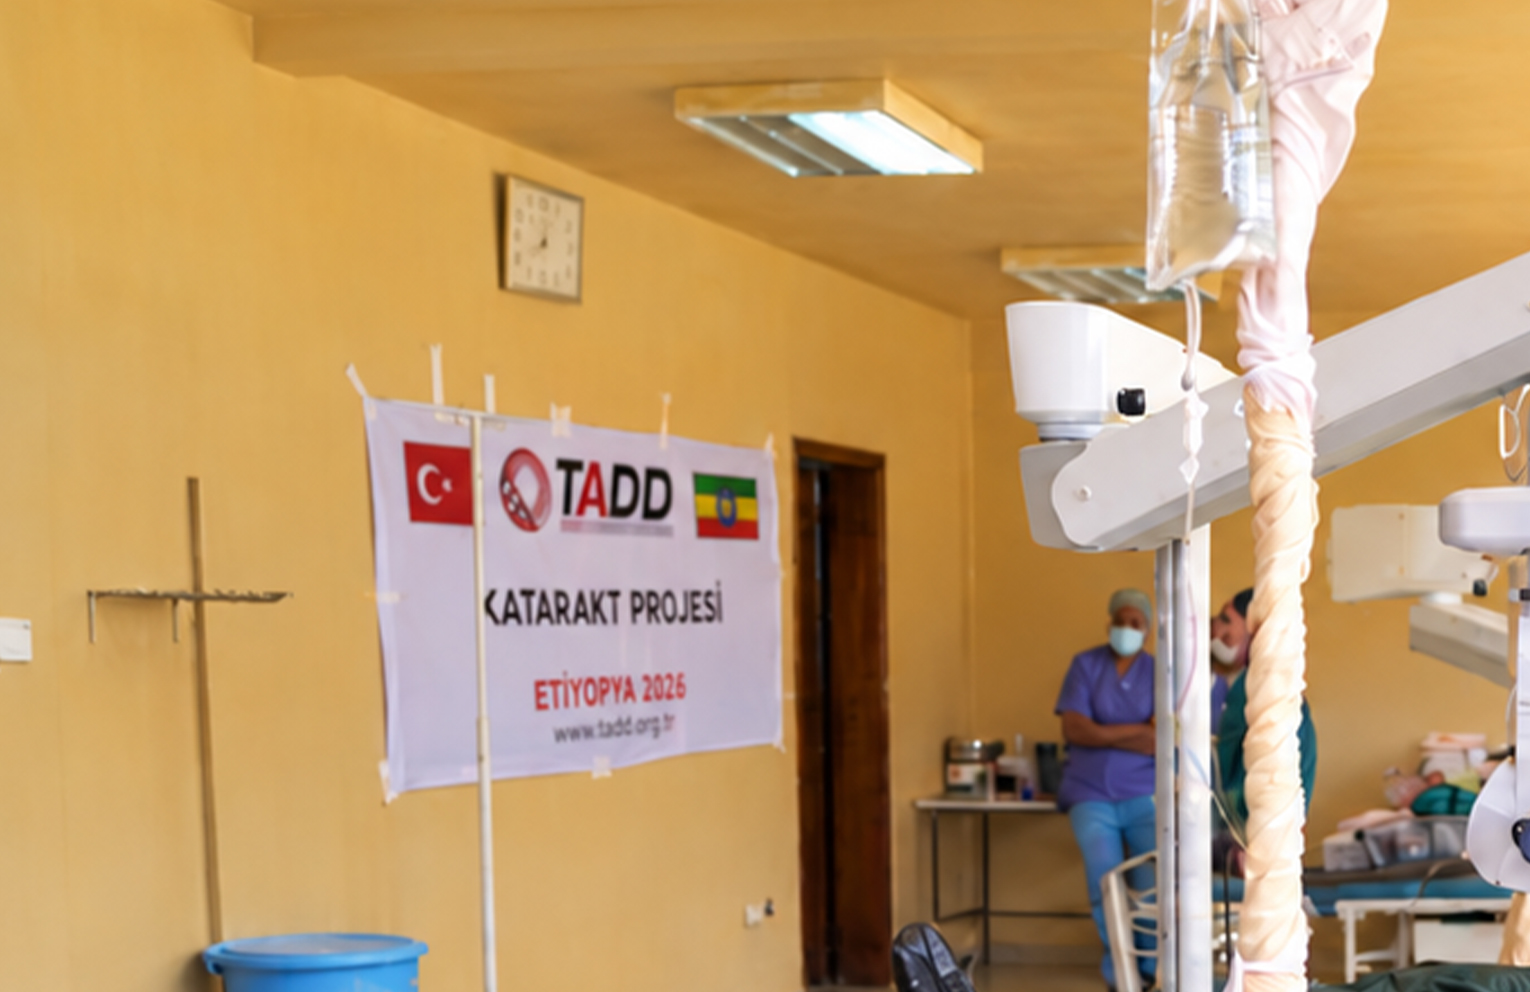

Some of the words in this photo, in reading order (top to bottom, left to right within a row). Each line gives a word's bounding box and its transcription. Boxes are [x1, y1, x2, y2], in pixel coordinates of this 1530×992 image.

[555, 457, 673, 521] TADD
[630, 579, 724, 624] PROJESİ
[534, 670, 637, 711] ETİYOPYA
[641, 672, 687, 703] 2026
[553, 713, 676, 744] www.tadd.org.tr
